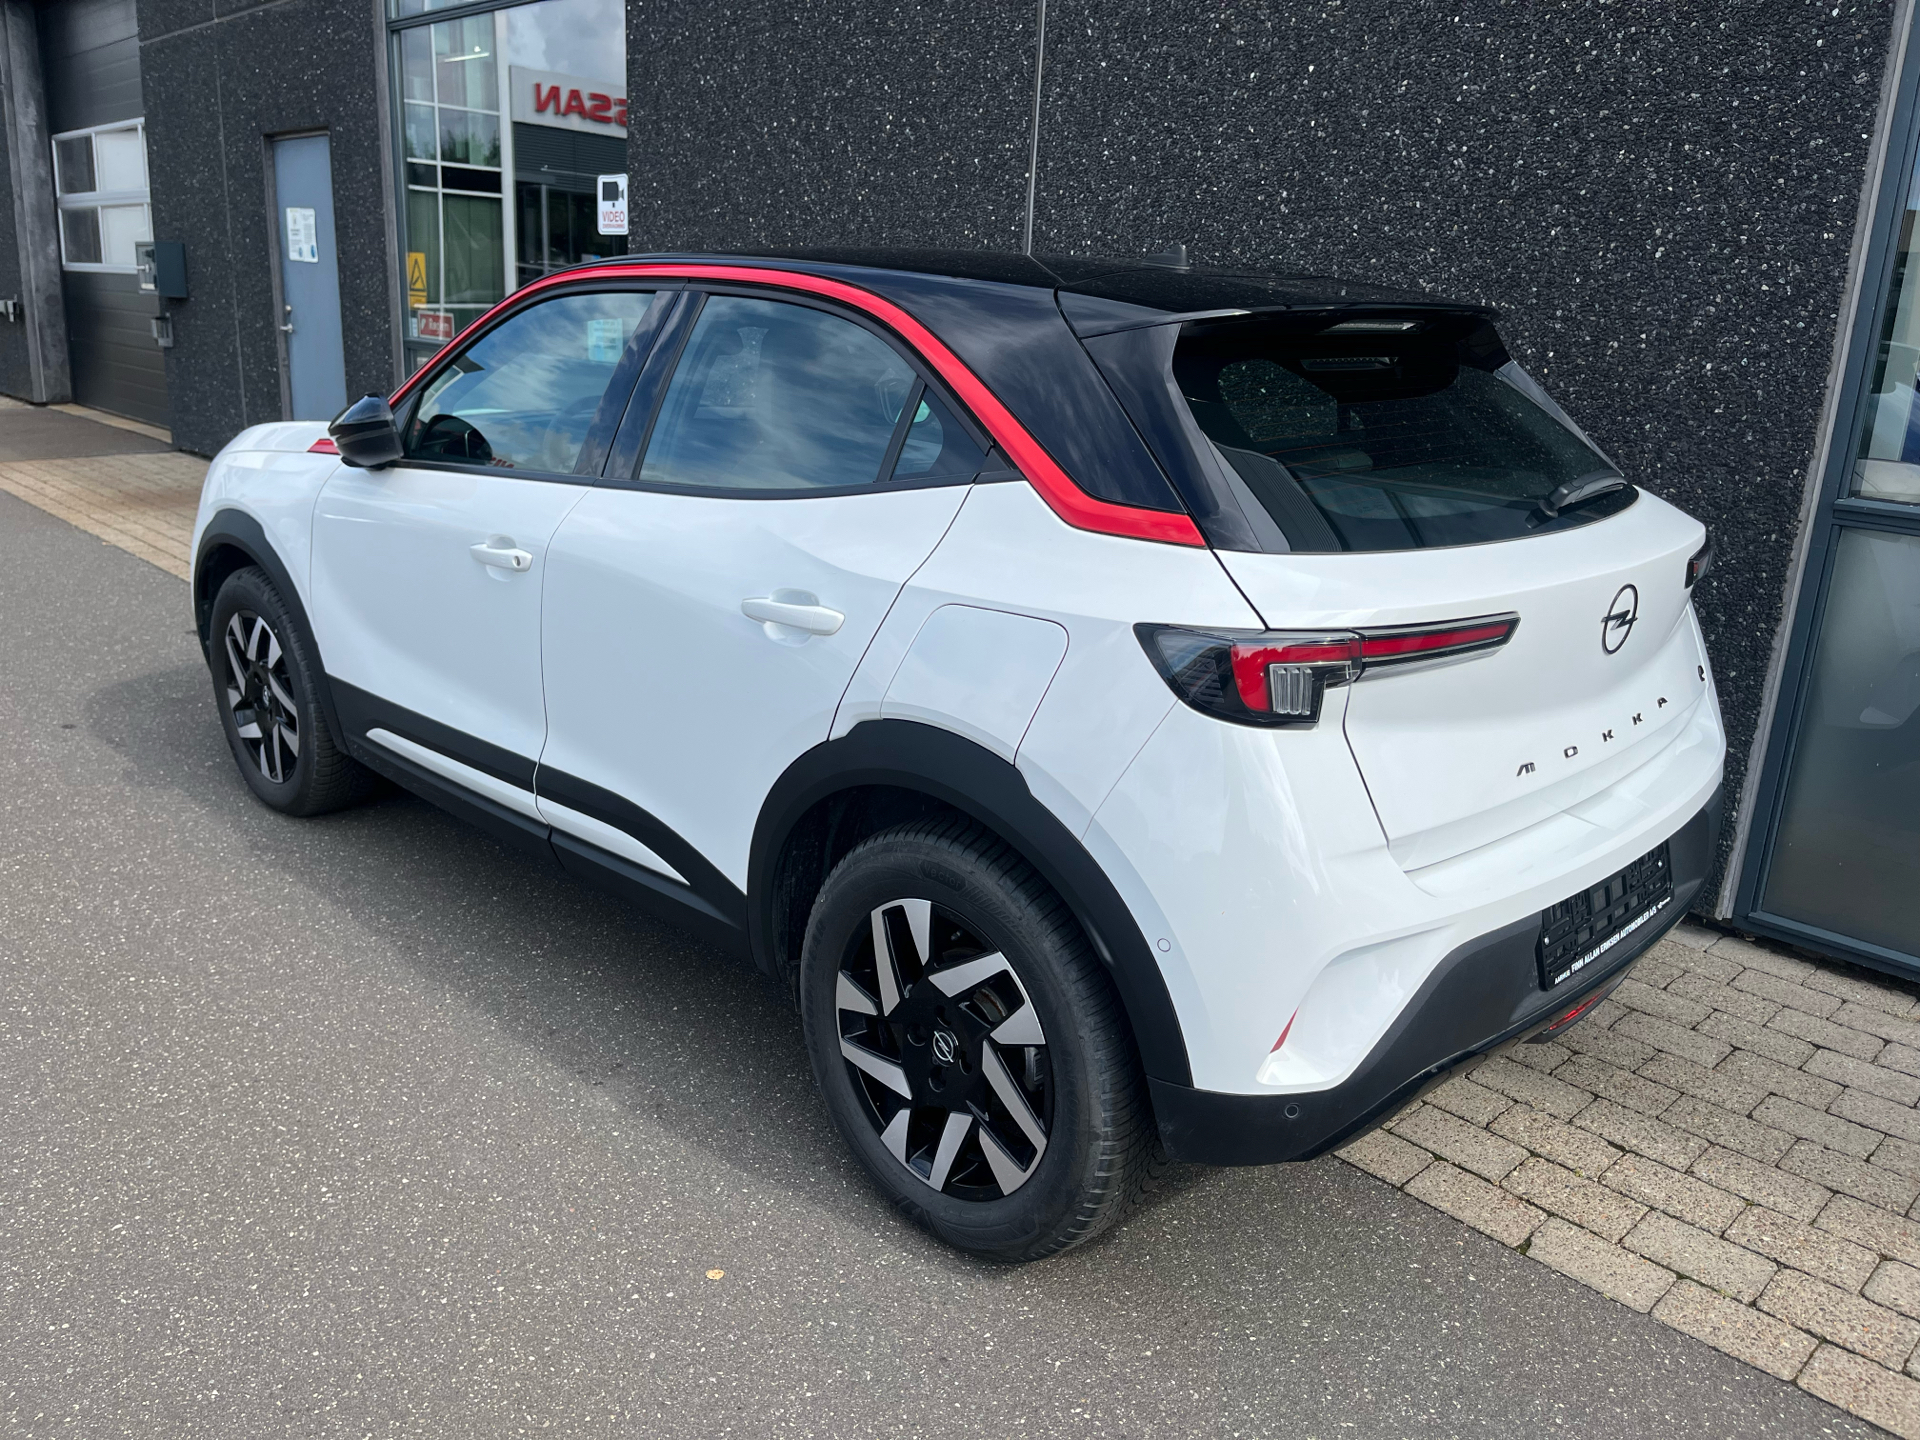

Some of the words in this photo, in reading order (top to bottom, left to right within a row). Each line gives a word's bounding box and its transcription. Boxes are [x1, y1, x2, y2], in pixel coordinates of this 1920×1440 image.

[602, 210, 625, 223] VIDEO
[1516, 696, 1668, 777] MOKKA
[924, 861, 961, 889] Vector
[1571, 957, 1584, 973] FINN
[1584, 946, 1601, 965] ALLAN
[1600, 932, 1620, 953] ERIKSEN
